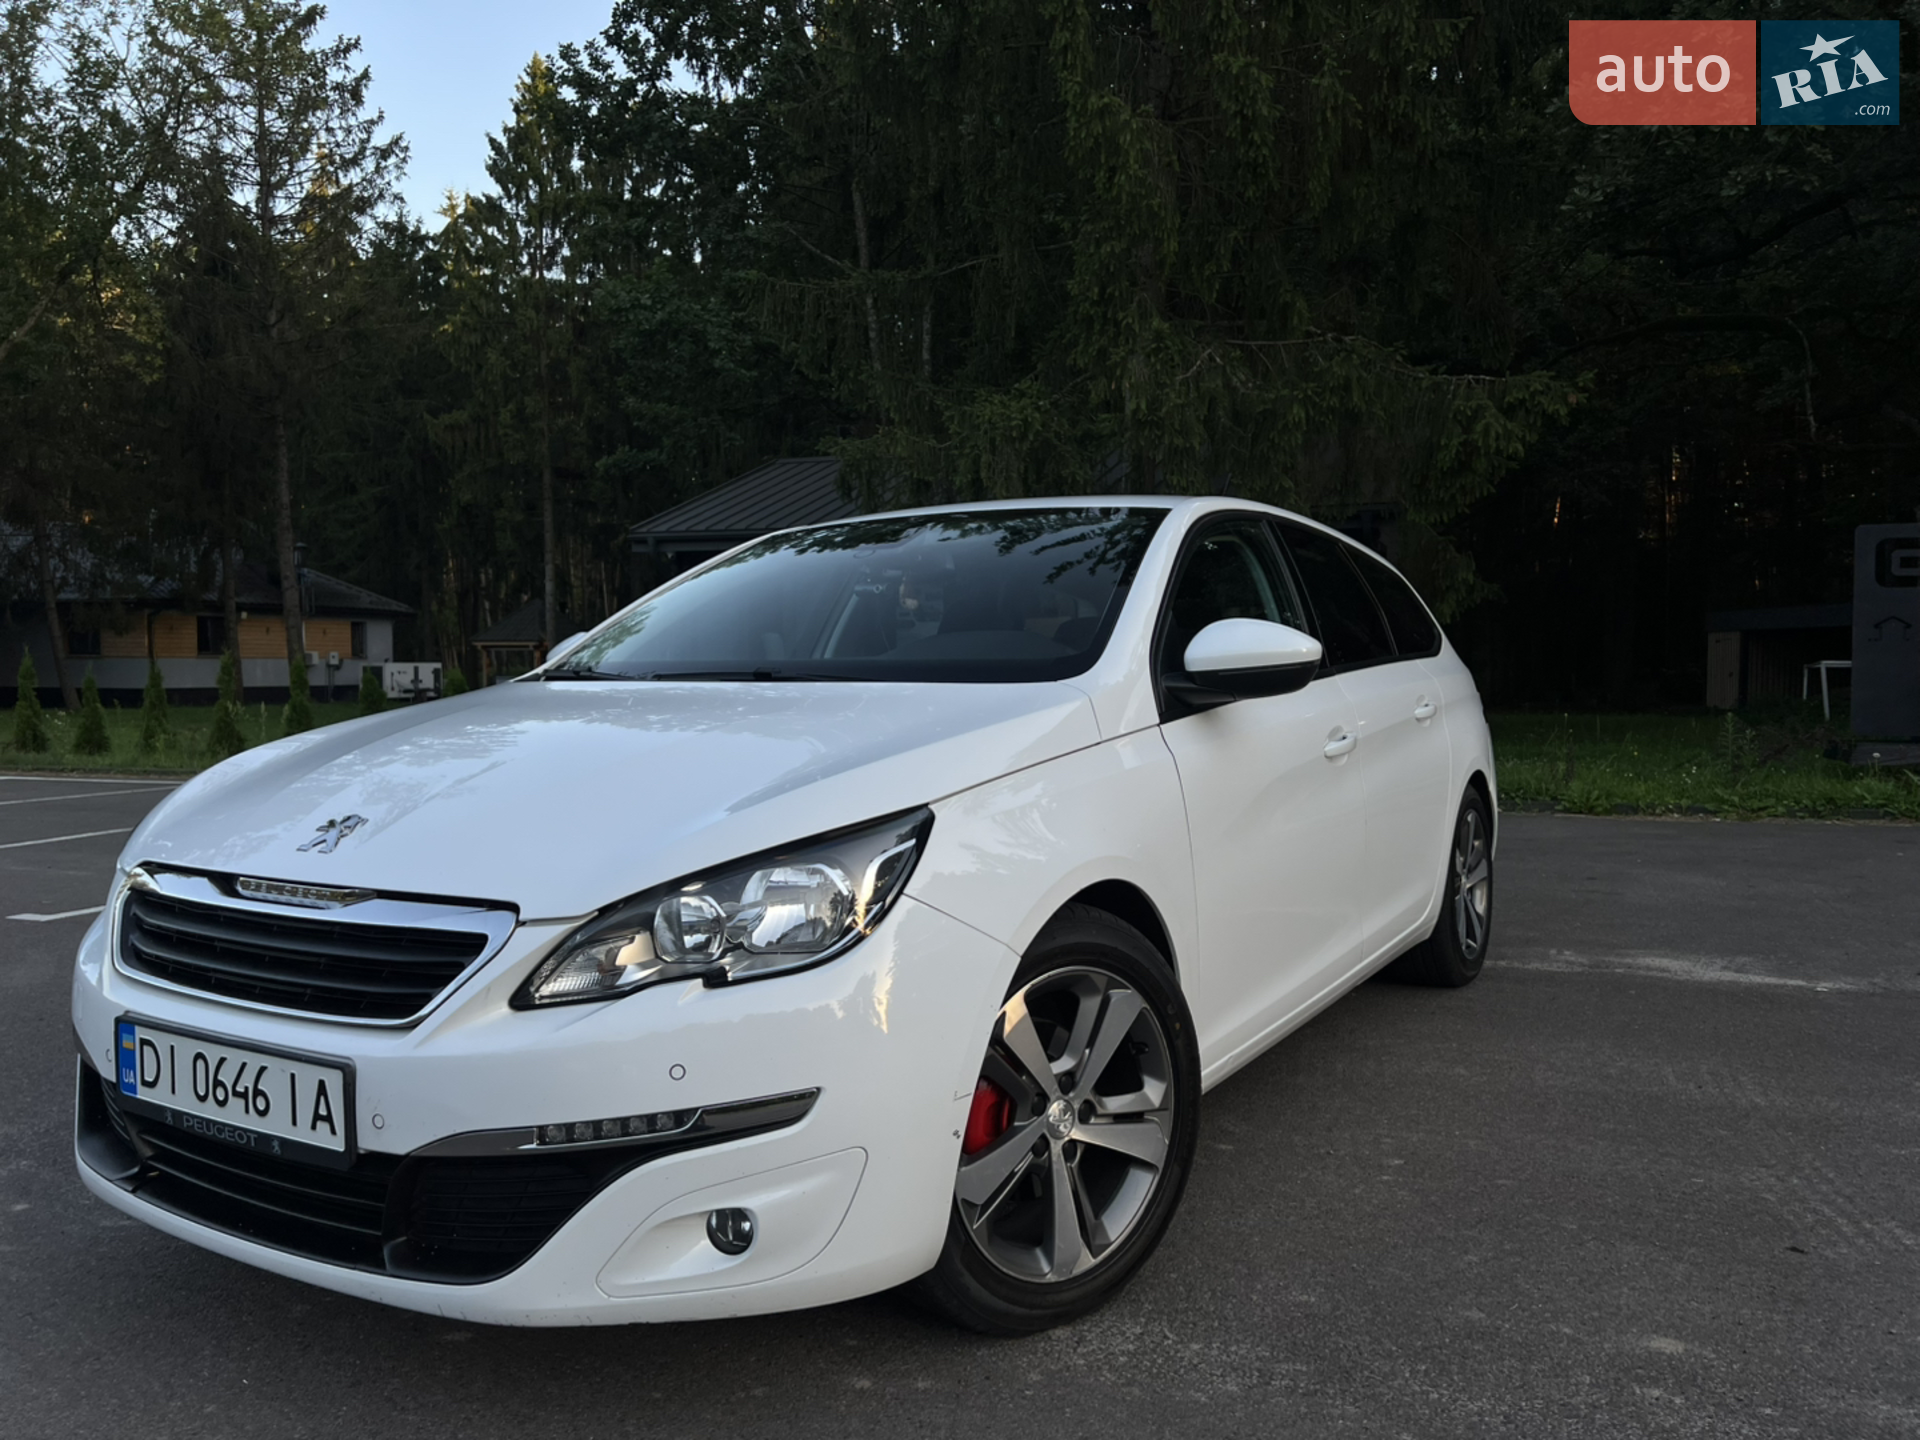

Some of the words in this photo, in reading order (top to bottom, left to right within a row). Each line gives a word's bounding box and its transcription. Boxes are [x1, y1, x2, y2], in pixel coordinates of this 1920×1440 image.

[122, 1067, 136, 1085] UA
[139, 1035, 177, 1096] DI
[192, 1050, 271, 1117] 0646
[289, 1070, 338, 1136] IA
[183, 1114, 258, 1147] PEUGEOT
